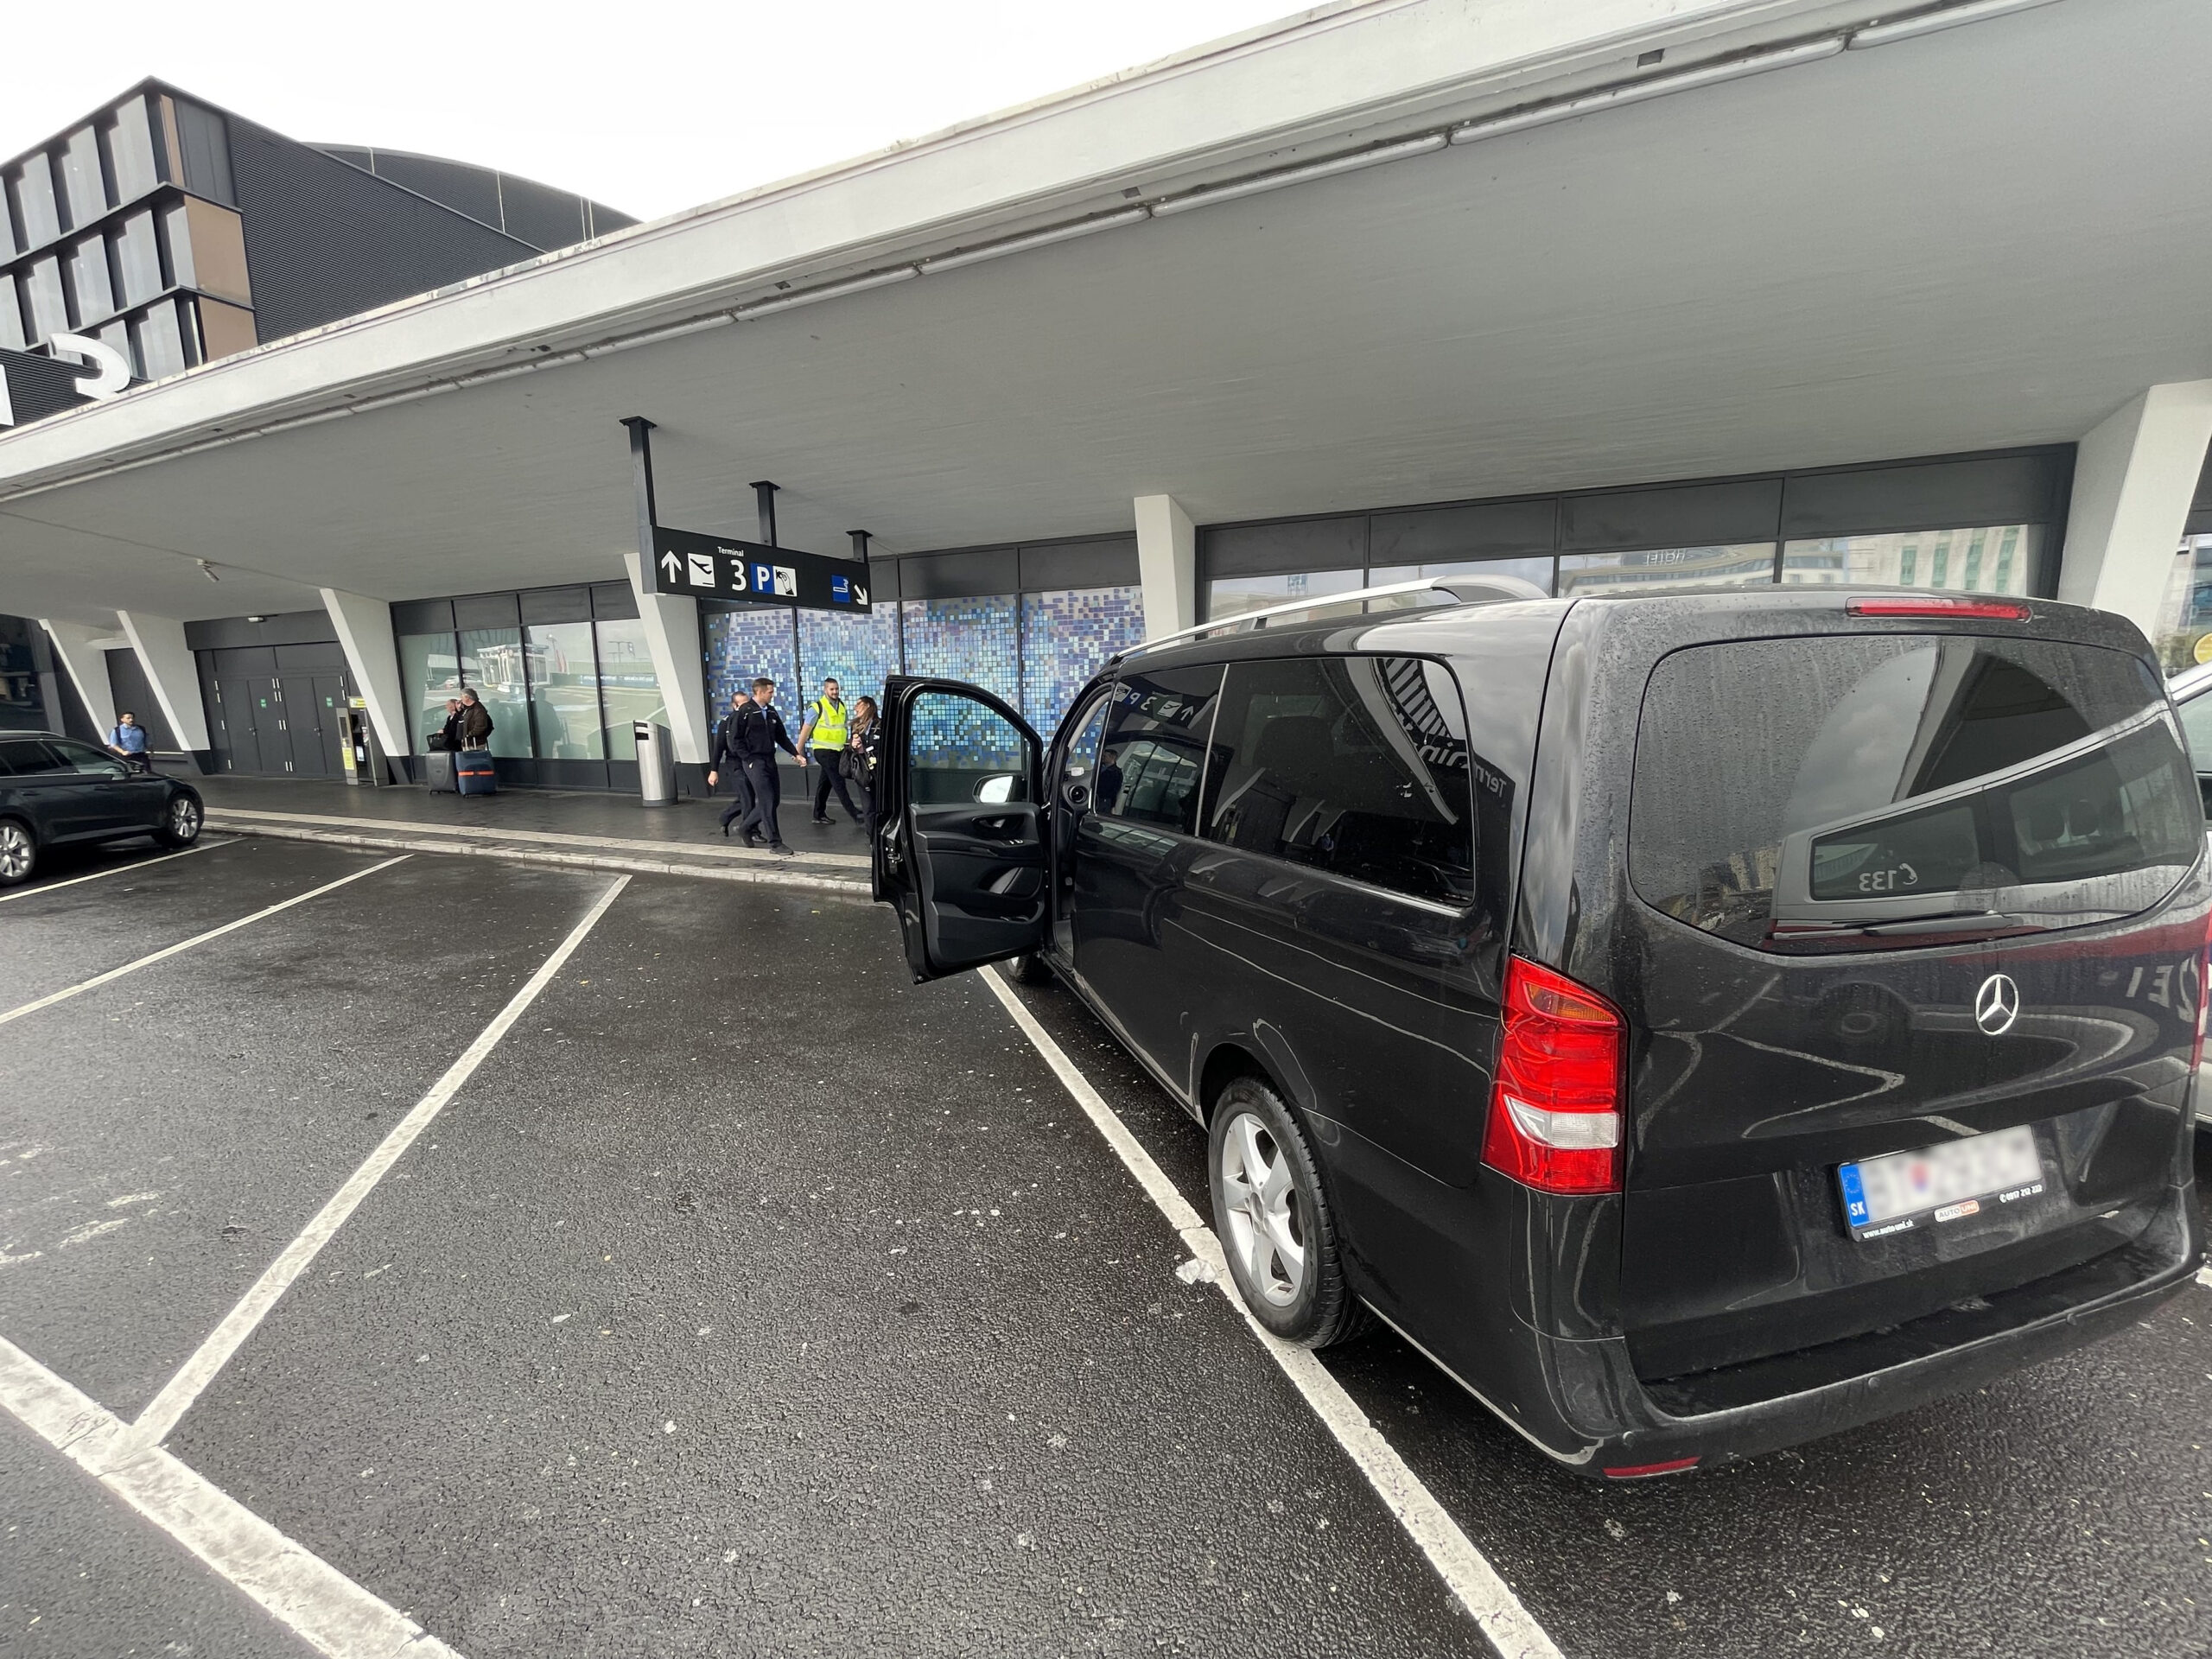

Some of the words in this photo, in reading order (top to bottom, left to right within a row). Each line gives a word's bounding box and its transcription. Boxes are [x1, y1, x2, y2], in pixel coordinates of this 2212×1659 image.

[717, 546, 744, 556] Terminal
[730, 559, 747, 591] 3
[757, 566, 770, 590] P
[1850, 1201, 1865, 1217] SK
